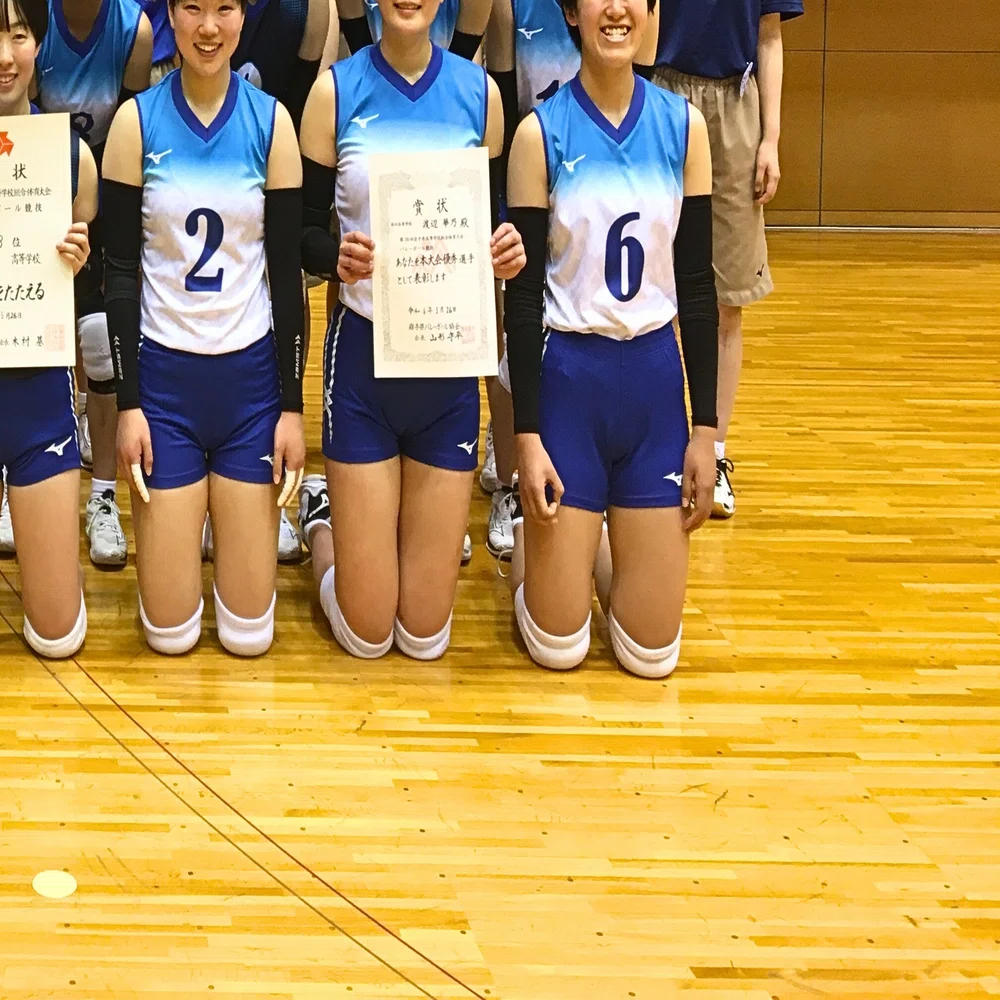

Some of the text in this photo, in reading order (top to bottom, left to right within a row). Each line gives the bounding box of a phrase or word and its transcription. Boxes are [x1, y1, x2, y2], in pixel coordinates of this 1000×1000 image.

[185, 207, 224, 292] 2
[412, 197, 449, 217] 賞状
[604, 211, 645, 303] 6
